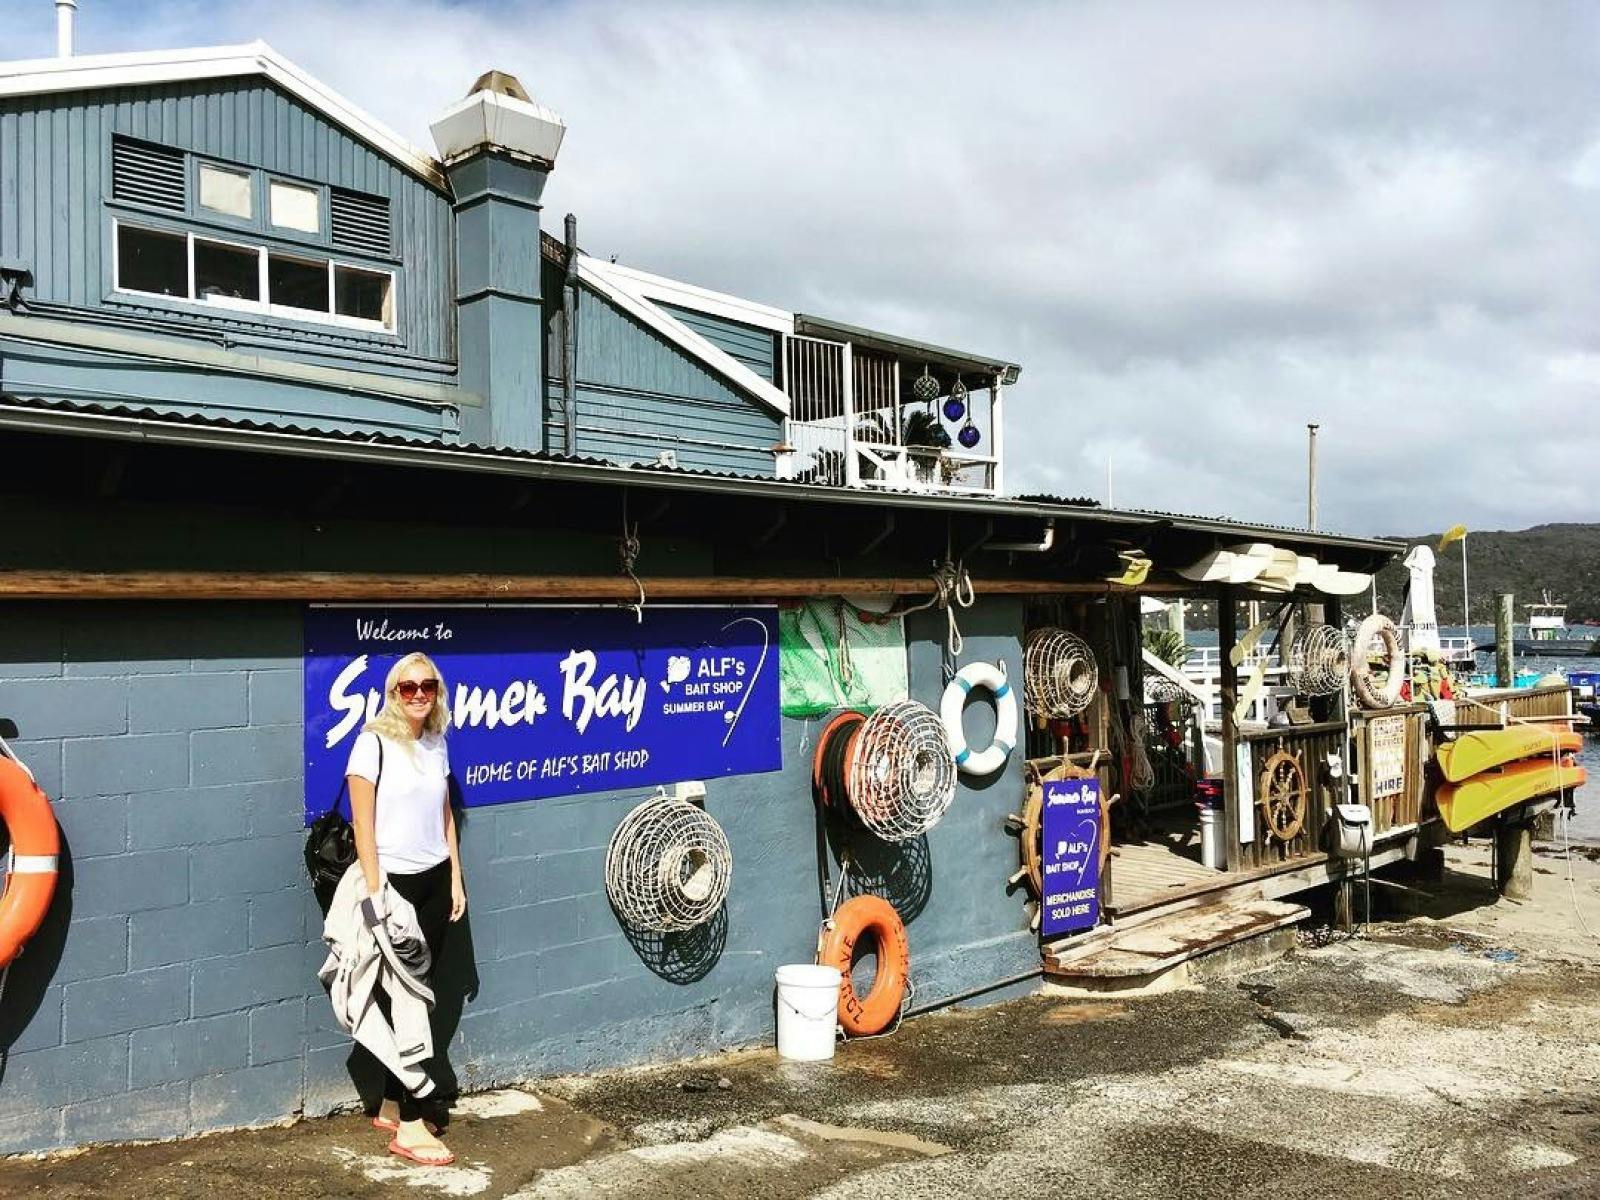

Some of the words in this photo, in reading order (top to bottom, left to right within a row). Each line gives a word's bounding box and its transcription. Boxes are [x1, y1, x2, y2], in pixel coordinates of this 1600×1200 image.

[356, 618, 430, 641] Welcome
[434, 622, 453, 641] to
[697, 657, 746, 677] ALF's
[685, 682, 711, 696] BAIT
[713, 681, 743, 694] SHOP
[325, 654, 548, 749] Smer
[560, 649, 647, 735] Bay
[663, 701, 705, 714] SUMMER
[706, 700, 725, 711] BAY
[466, 761, 513, 786] HOME
[516, 759, 537, 780] OF
[540, 755, 579, 779] ALF'S
[581, 752, 611, 774] BAIT
[614, 749, 650, 770] SHOP
[1375, 777, 1403, 795] HIRE
[1046, 864, 1061, 874] BAIT
[1062, 861, 1079, 872] SHOP
[1046, 889, 1095, 906] MERCHANDISE
[1052, 907, 1071, 920] SOLD
[1072, 904, 1090, 916] HERE
